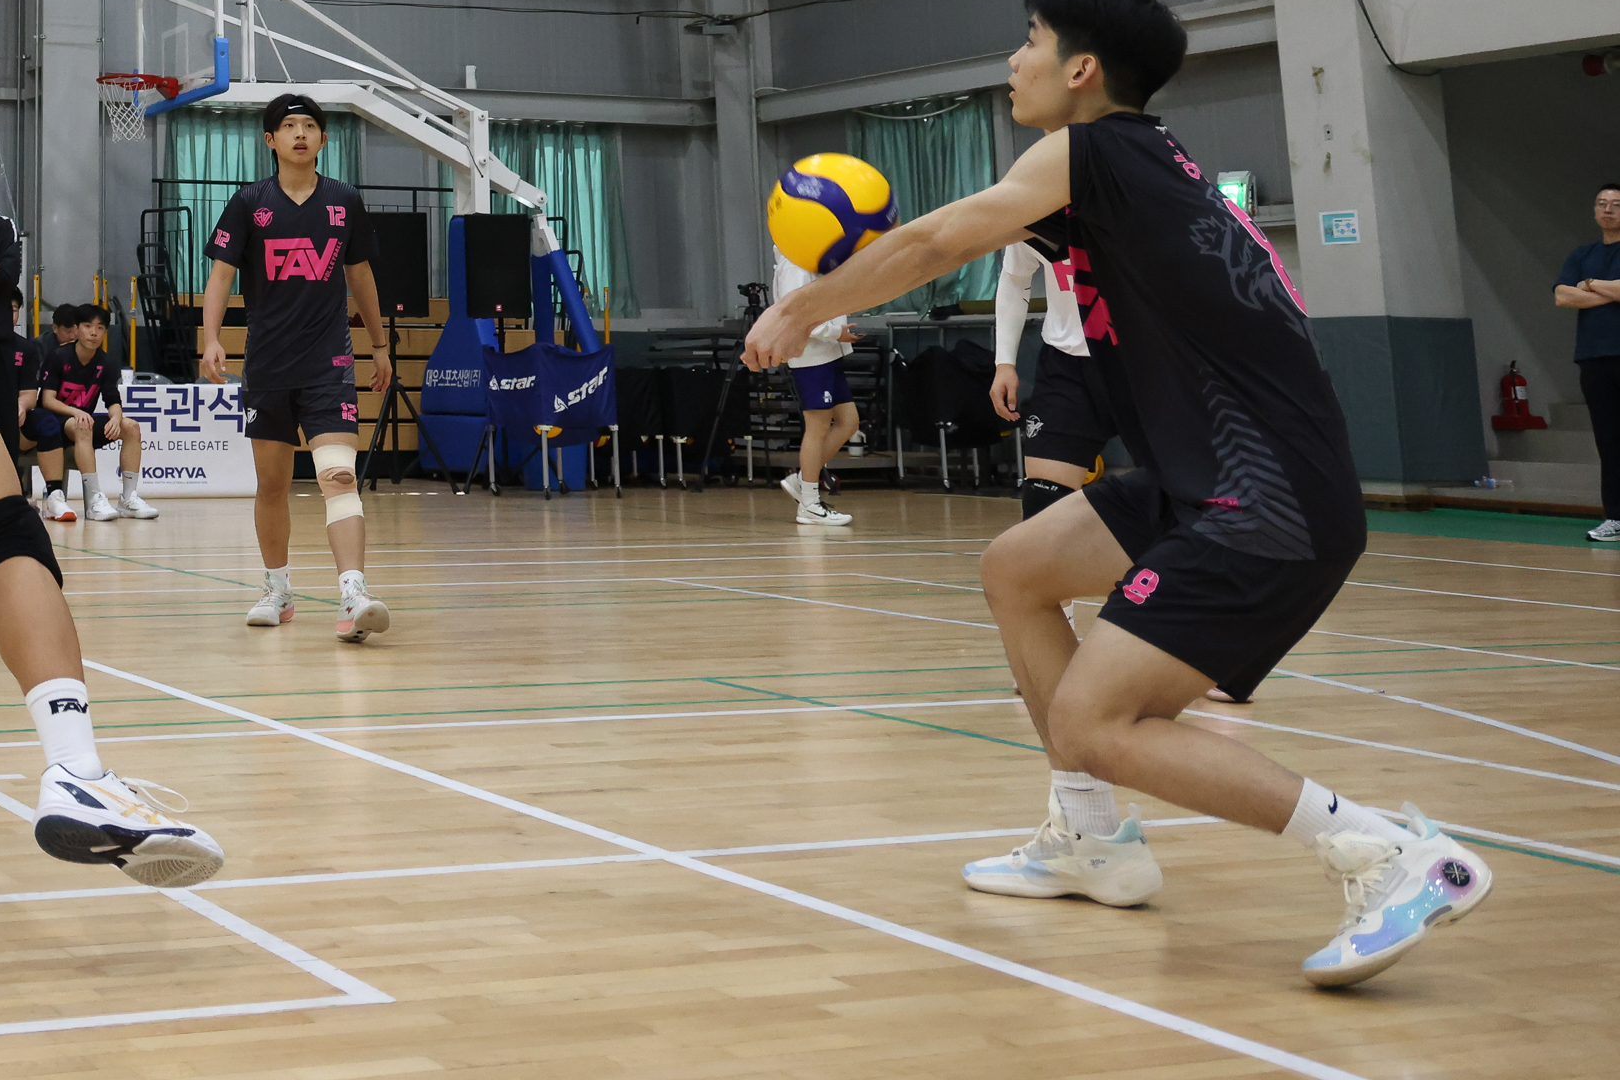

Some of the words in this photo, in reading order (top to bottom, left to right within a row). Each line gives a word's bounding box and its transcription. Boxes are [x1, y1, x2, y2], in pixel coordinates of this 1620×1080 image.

[326, 205, 346, 227] 12
[214, 229, 230, 248] 12
[264, 237, 339, 281] FAV
[323, 241, 343, 282] VOLLEYBALL
[120, 386, 244, 433] 독관석
[168, 440, 229, 451] DELEGATE
[142, 466, 206, 479] KORYVA
[48, 697, 89, 715] FAV
